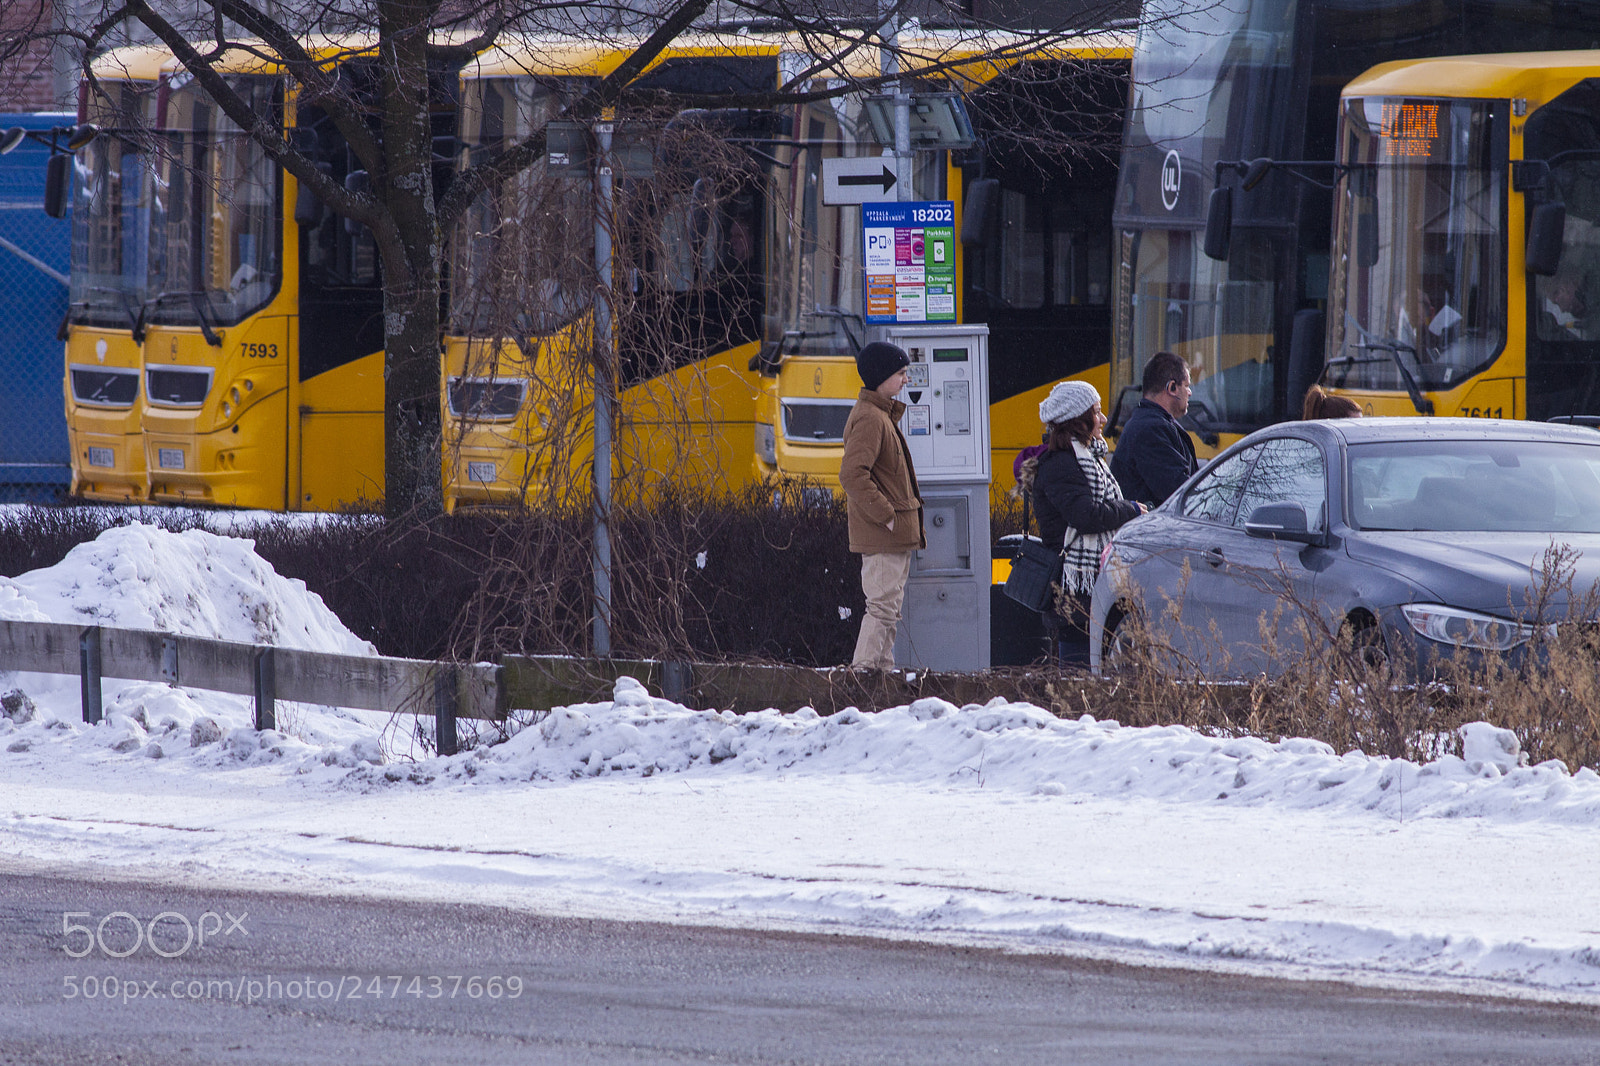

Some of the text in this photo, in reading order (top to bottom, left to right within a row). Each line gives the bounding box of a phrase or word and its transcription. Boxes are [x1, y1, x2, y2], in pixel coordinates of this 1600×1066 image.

[1402, 105, 1439, 137] TRAFIK
[911, 209, 952, 222] 18202
[869, 236, 878, 249] P
[240, 343, 278, 359] 7593
[1461, 407, 1503, 419] 7611
